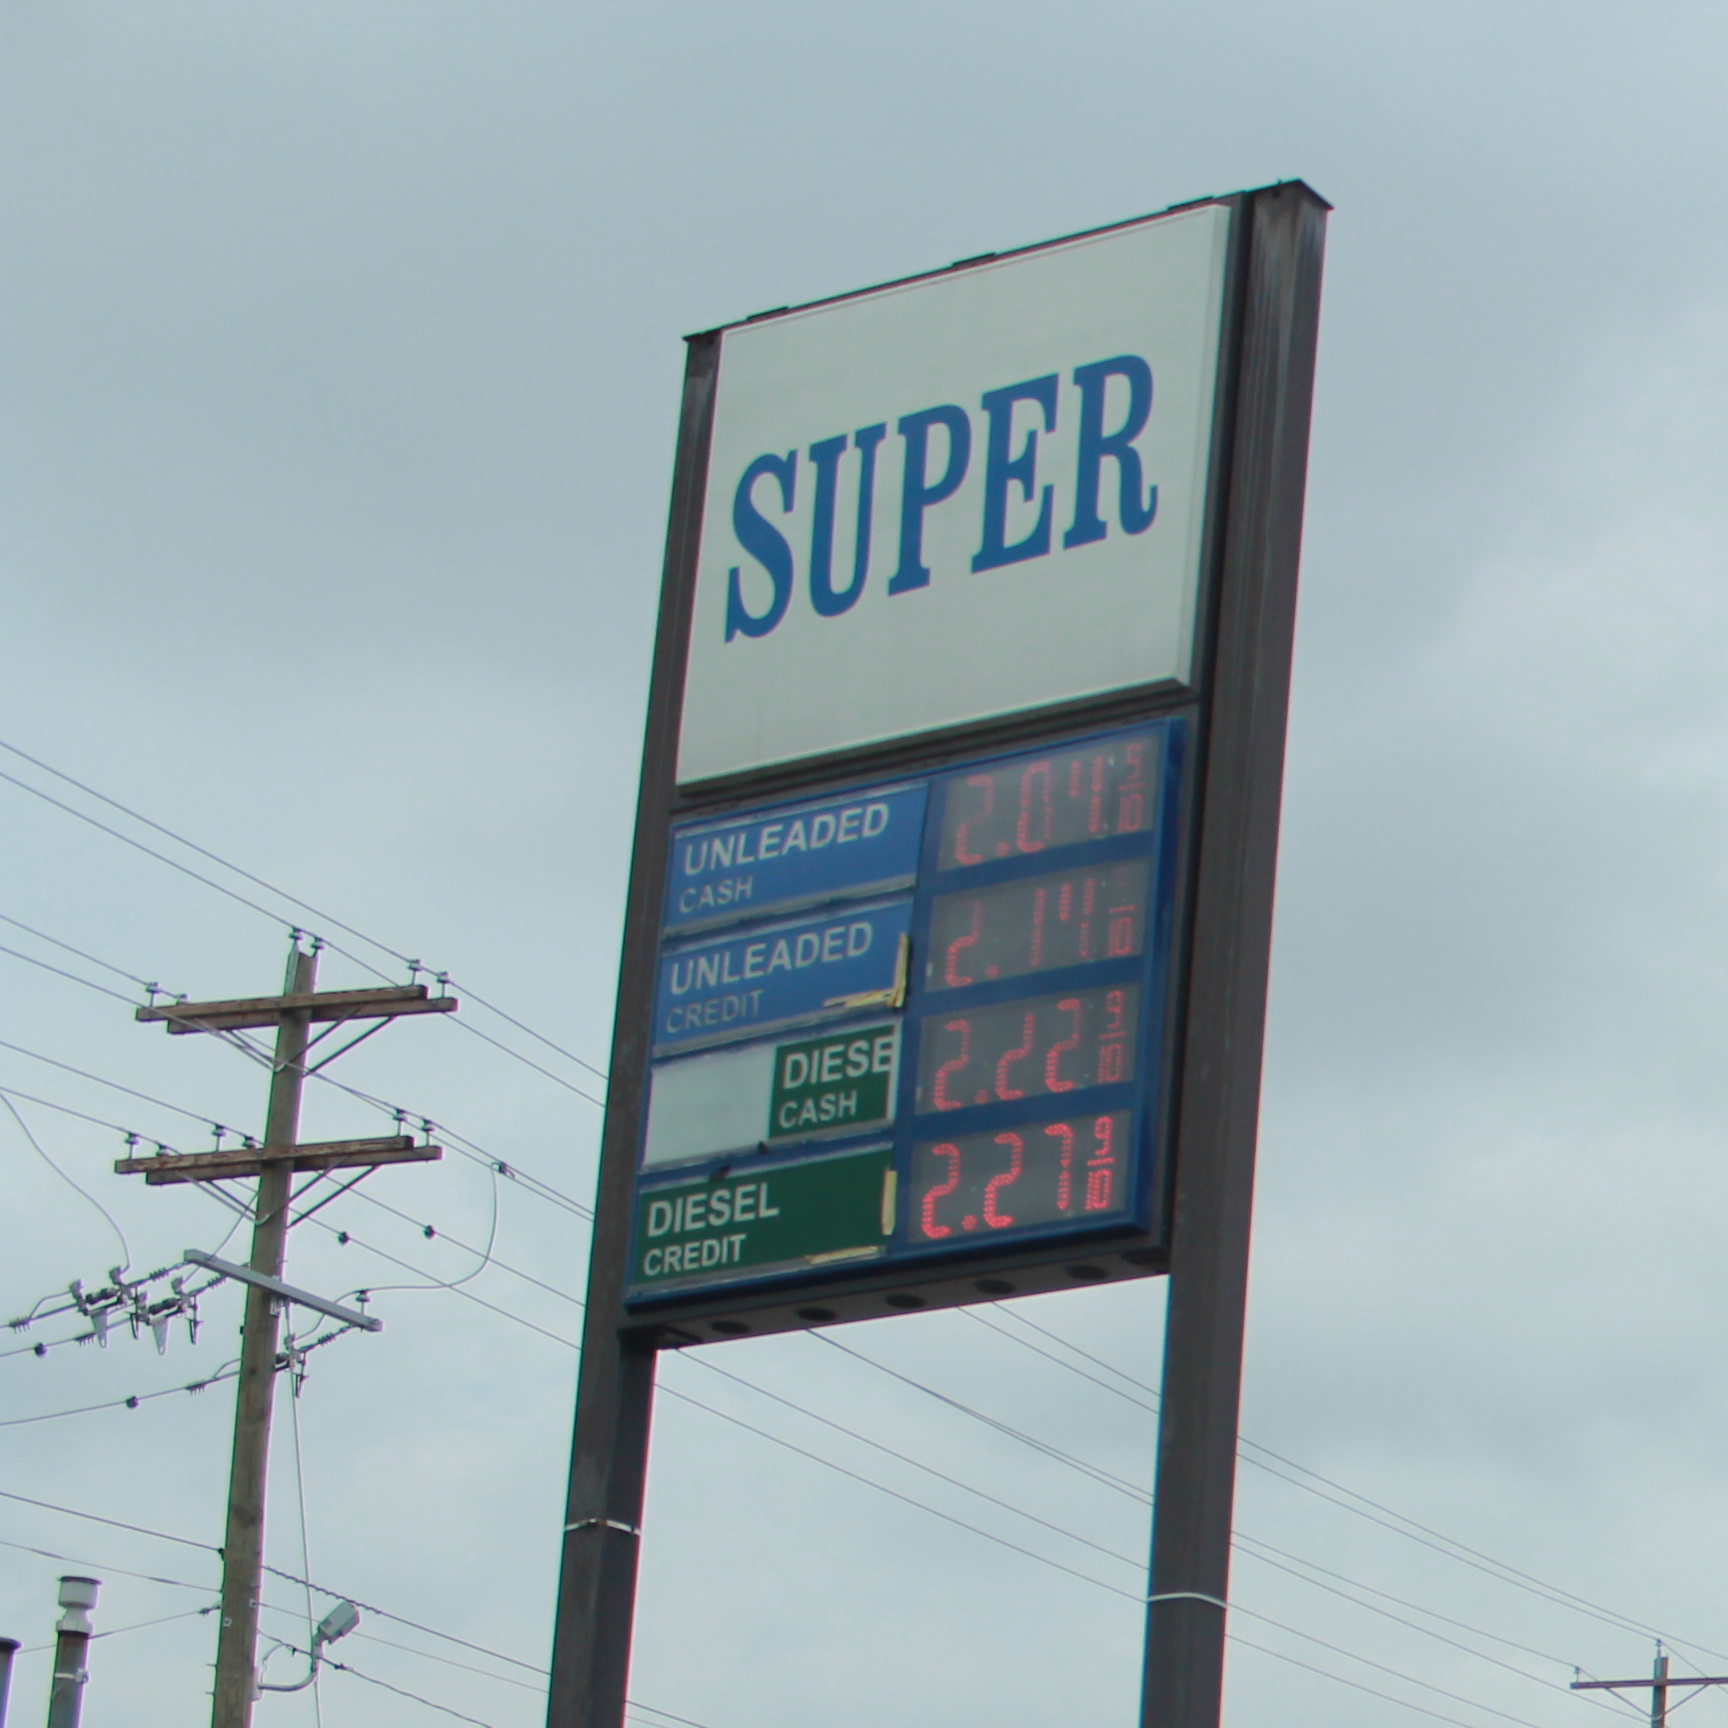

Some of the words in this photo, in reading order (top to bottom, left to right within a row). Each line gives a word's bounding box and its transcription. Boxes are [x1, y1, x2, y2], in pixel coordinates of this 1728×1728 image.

[723, 353, 1159, 644] SUPER
[683, 802, 890, 878] UNLEADED
[679, 876, 753, 914] CASH
[669, 920, 874, 996] UNLEADED
[665, 988, 765, 1034] CREDIT
[933, 998, 1081, 1112] 2.22
[779, 1090, 858, 1130] CASH
[646, 1183, 780, 1238] DIESEL
[921, 1123, 1076, 1240] 2.27
[642, 1233, 747, 1277] CREDIT
